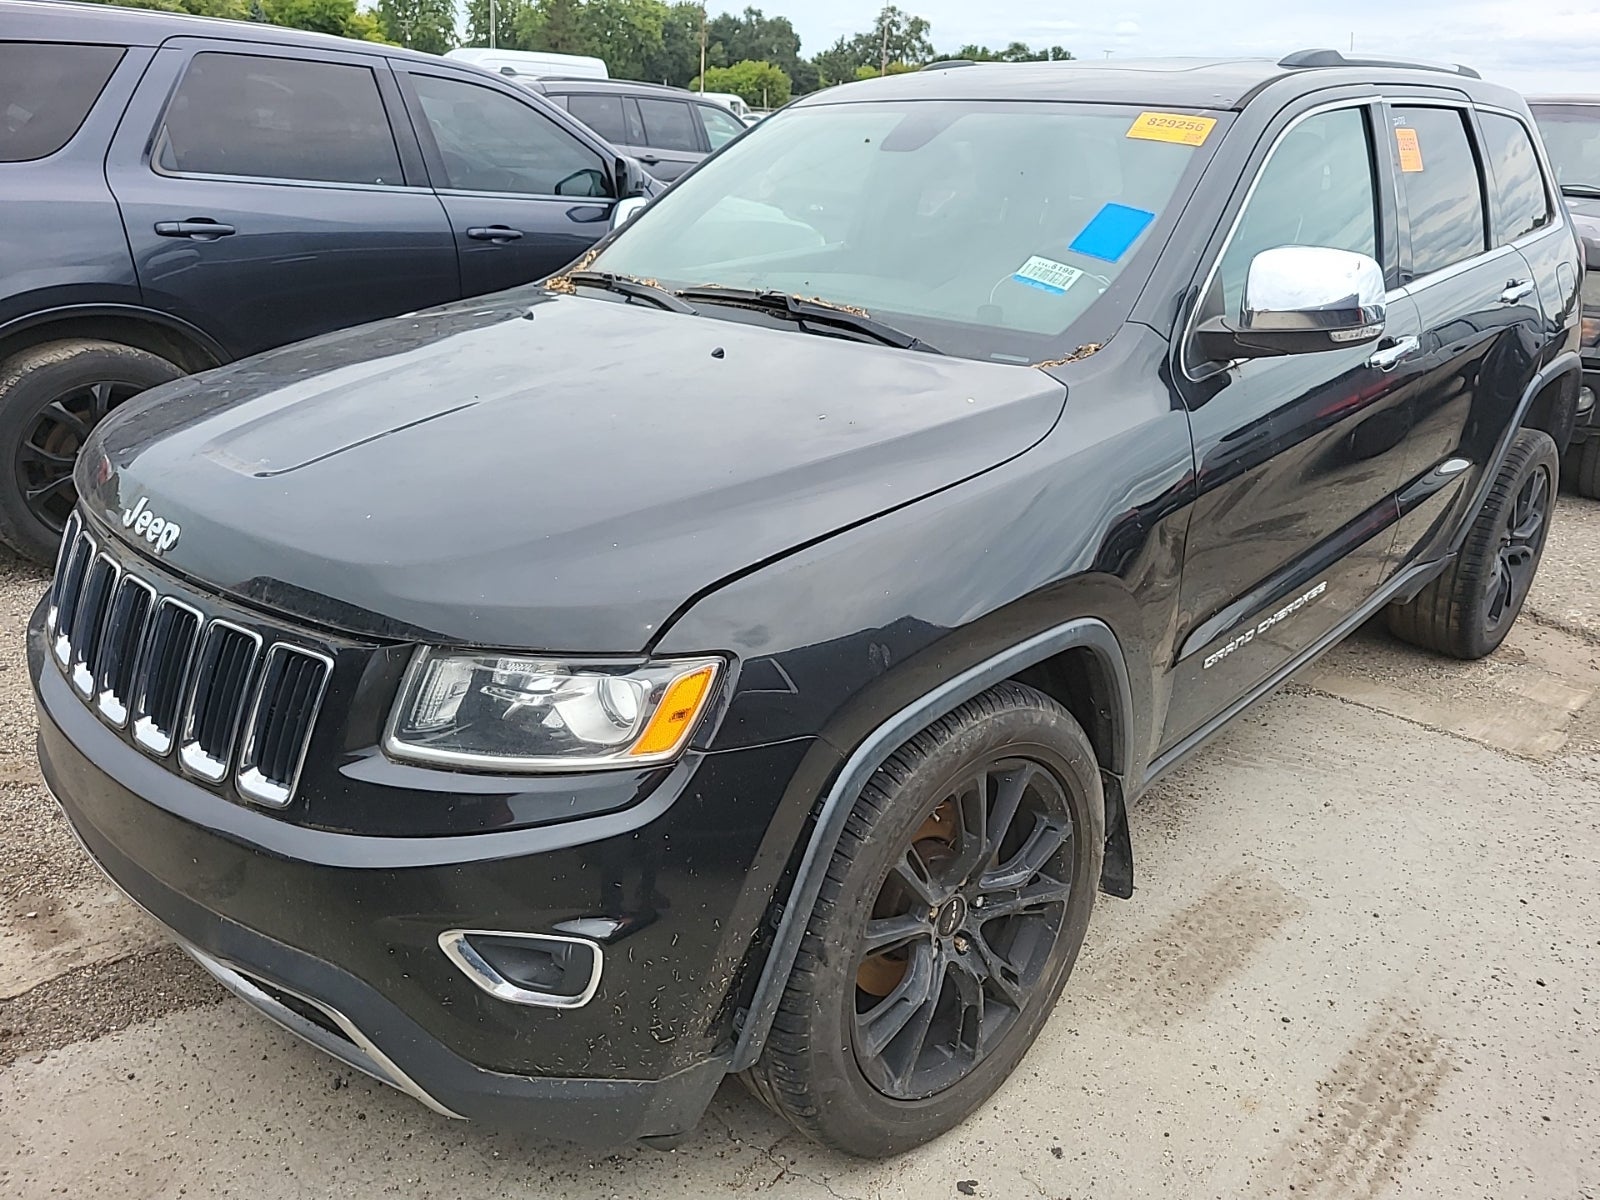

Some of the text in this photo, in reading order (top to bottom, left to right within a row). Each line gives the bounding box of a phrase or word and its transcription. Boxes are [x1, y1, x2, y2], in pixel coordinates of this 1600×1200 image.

[1146, 117, 1205, 132] 829256
[122, 496, 181, 555] Jeep
[1203, 580, 1328, 669] GRAND CHEROKEE
